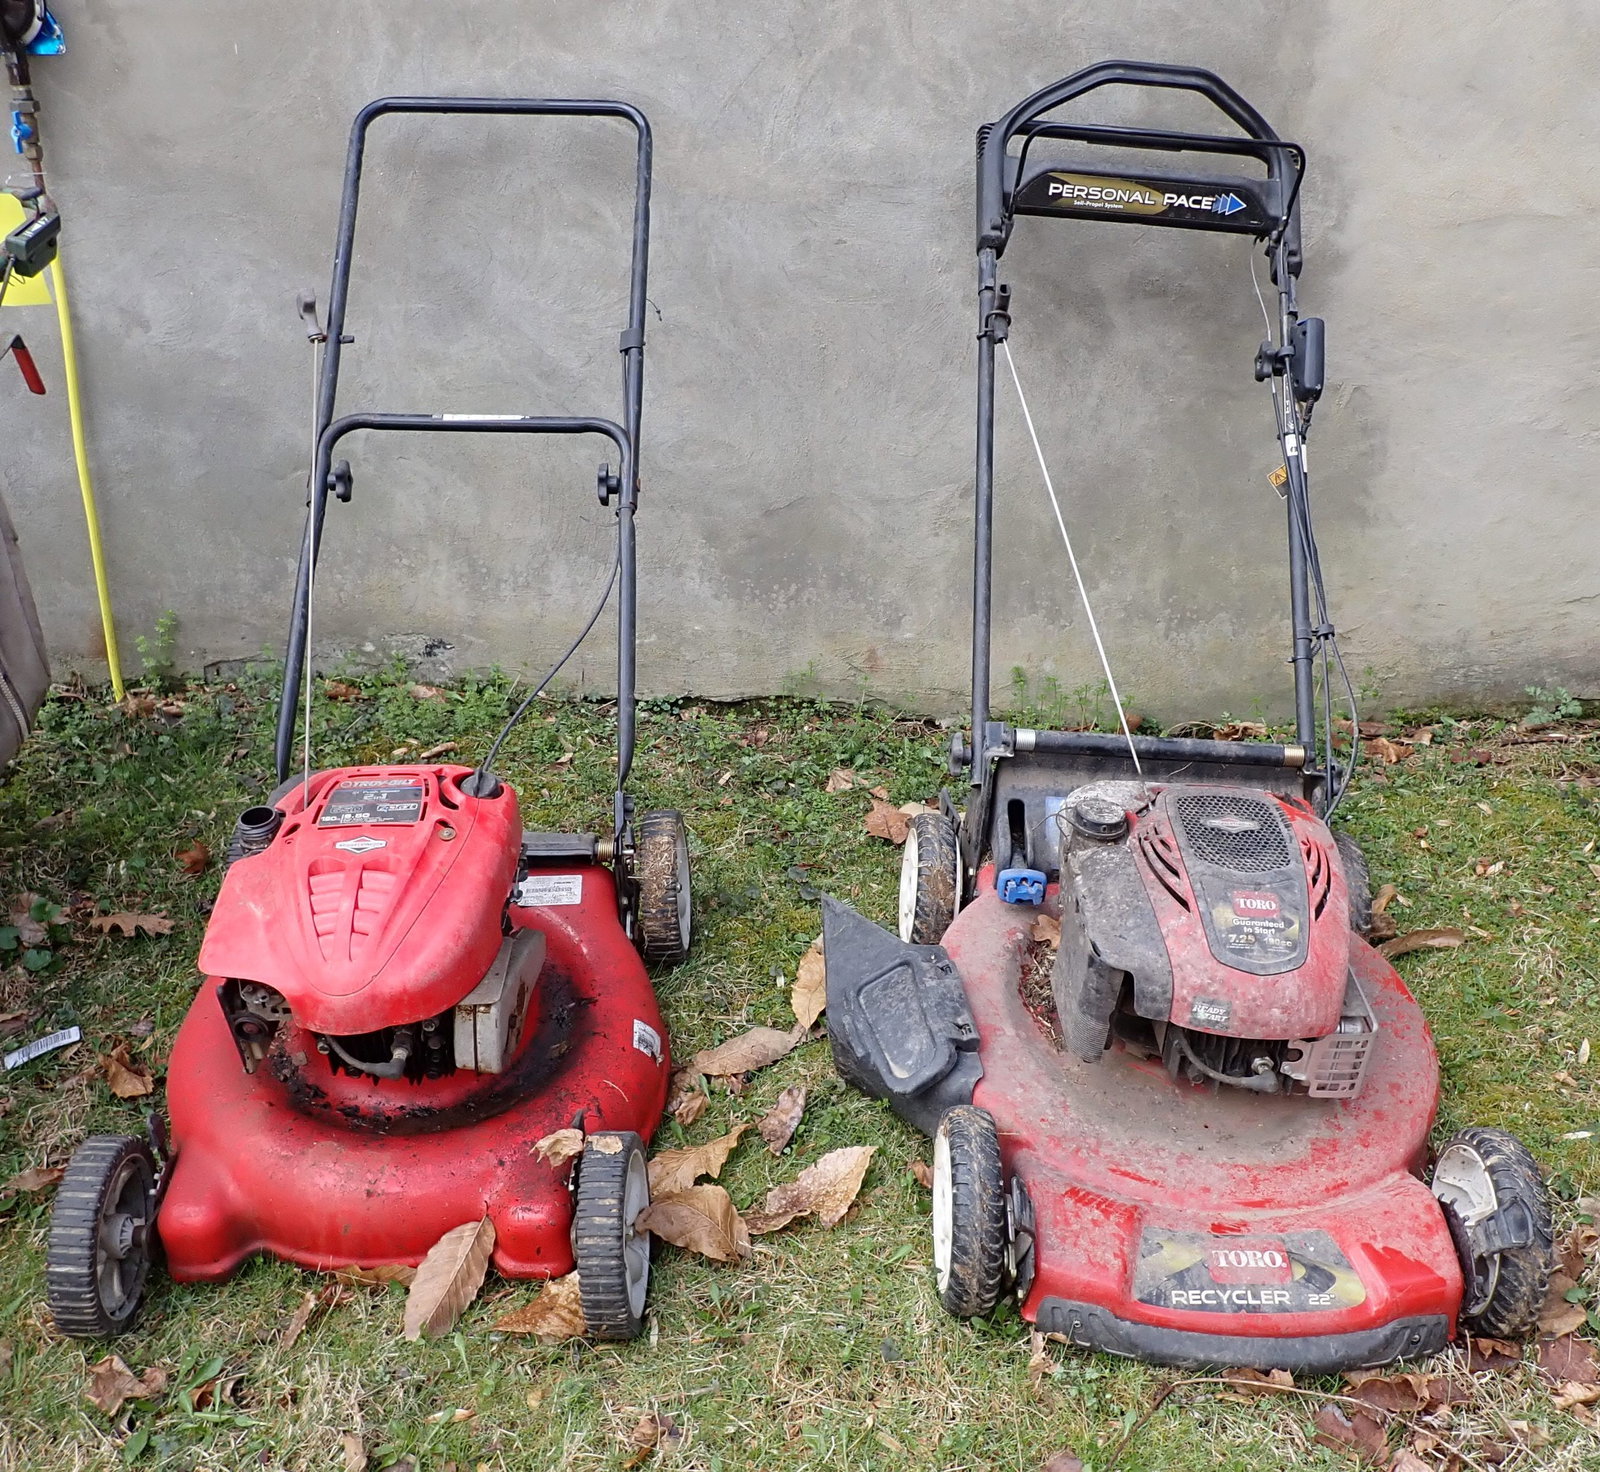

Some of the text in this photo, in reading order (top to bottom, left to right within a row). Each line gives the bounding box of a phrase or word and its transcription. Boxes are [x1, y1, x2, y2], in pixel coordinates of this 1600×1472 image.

[1048, 182, 1213, 210] PERSONAL PACE
[1235, 898, 1277, 911] TORO
[1232, 918, 1285, 929] Guaranteed
[1254, 926, 1276, 935] Start
[1211, 1249, 1284, 1269] TORO
[1170, 1290, 1336, 1305] RECYCLER 22"
